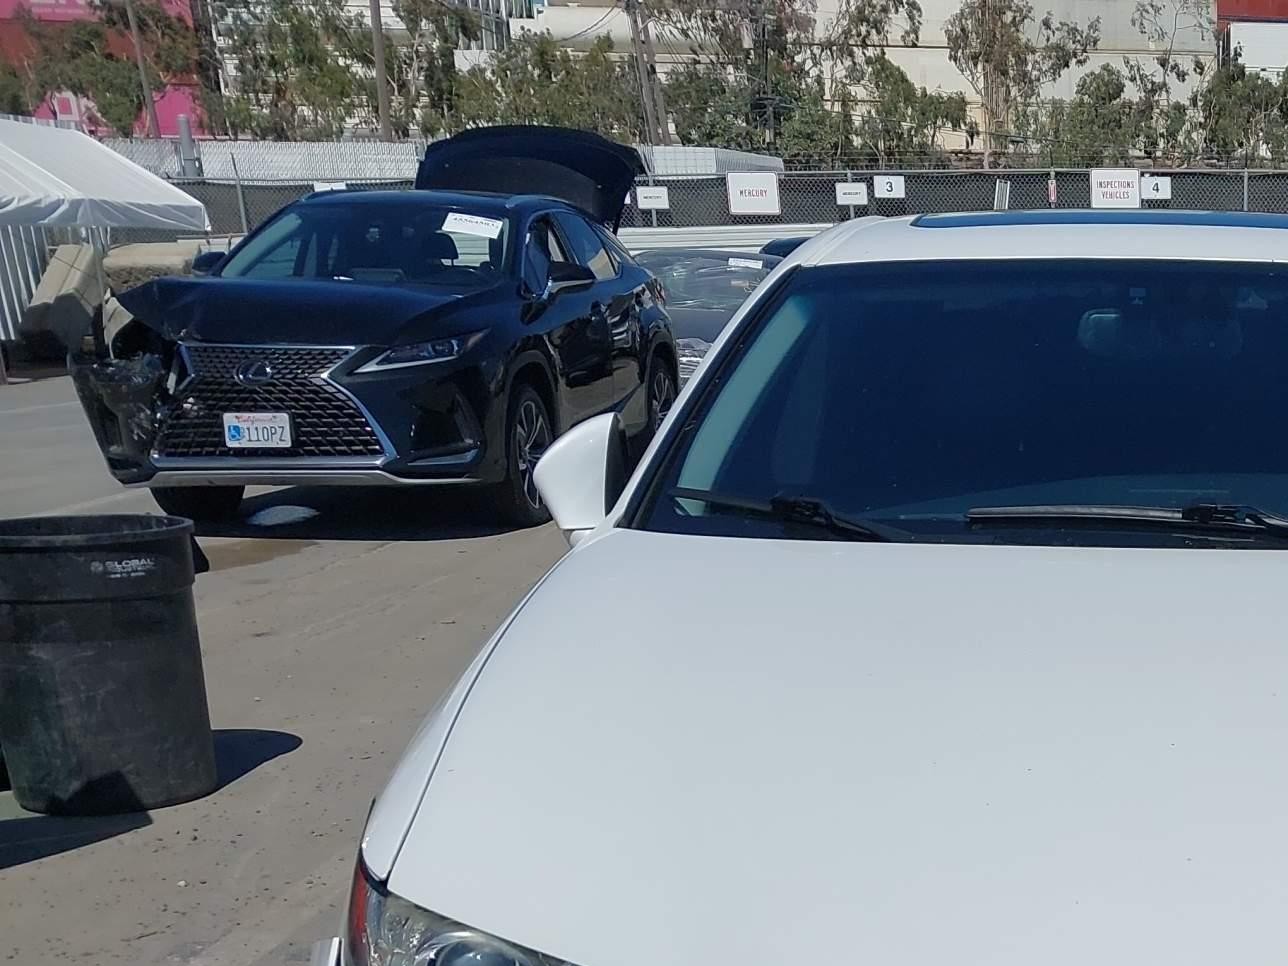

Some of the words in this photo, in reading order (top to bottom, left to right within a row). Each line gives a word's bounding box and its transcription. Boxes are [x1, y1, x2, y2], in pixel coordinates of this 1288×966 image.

[885, 181, 894, 193] 3
[1096, 180, 1135, 189] INSPECTIONS
[1152, 182, 1160, 193] 4
[739, 189, 768, 198] MERCURY
[1101, 190, 1130, 199] VEHICLES
